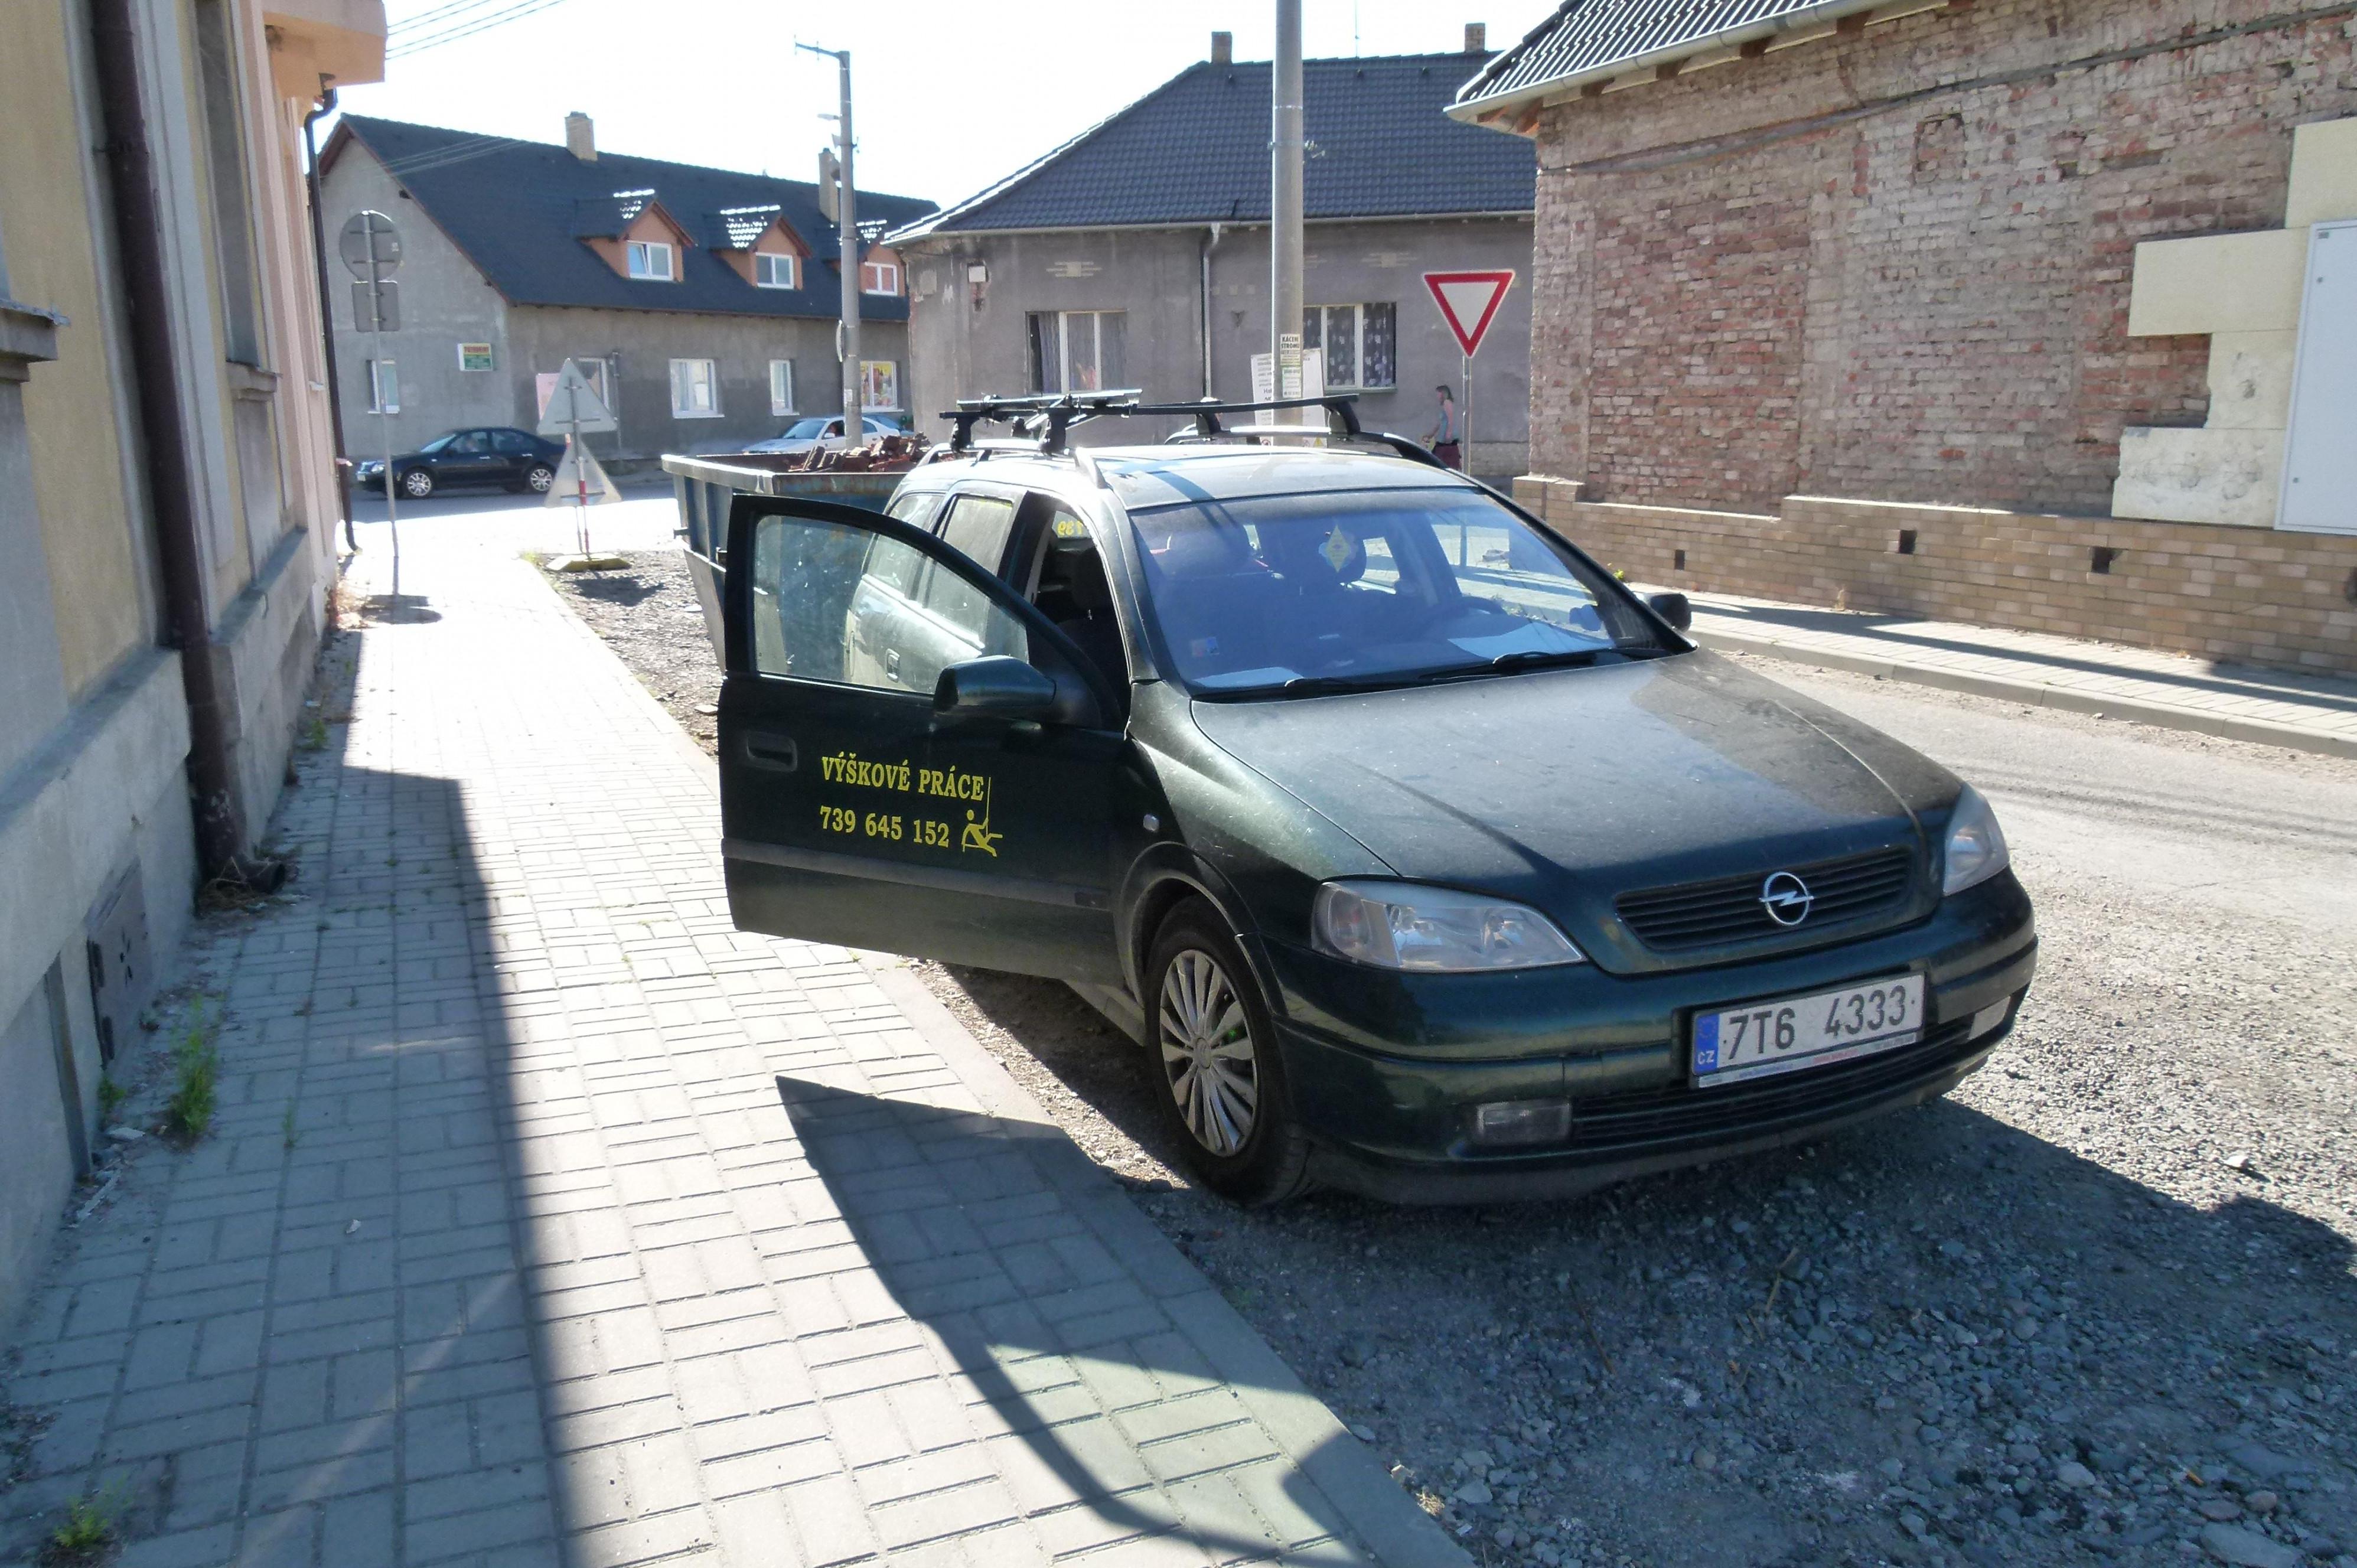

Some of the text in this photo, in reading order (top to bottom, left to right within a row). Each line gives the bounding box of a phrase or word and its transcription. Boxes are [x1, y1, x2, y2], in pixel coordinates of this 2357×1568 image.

[821, 751, 984, 801] VÝŠKOVÉ PRÁCE
[820, 805, 949, 847] 739 645 152
[1728, 985, 1906, 1060] 7T6 4333
[1698, 1049, 1715, 1065] CZ
